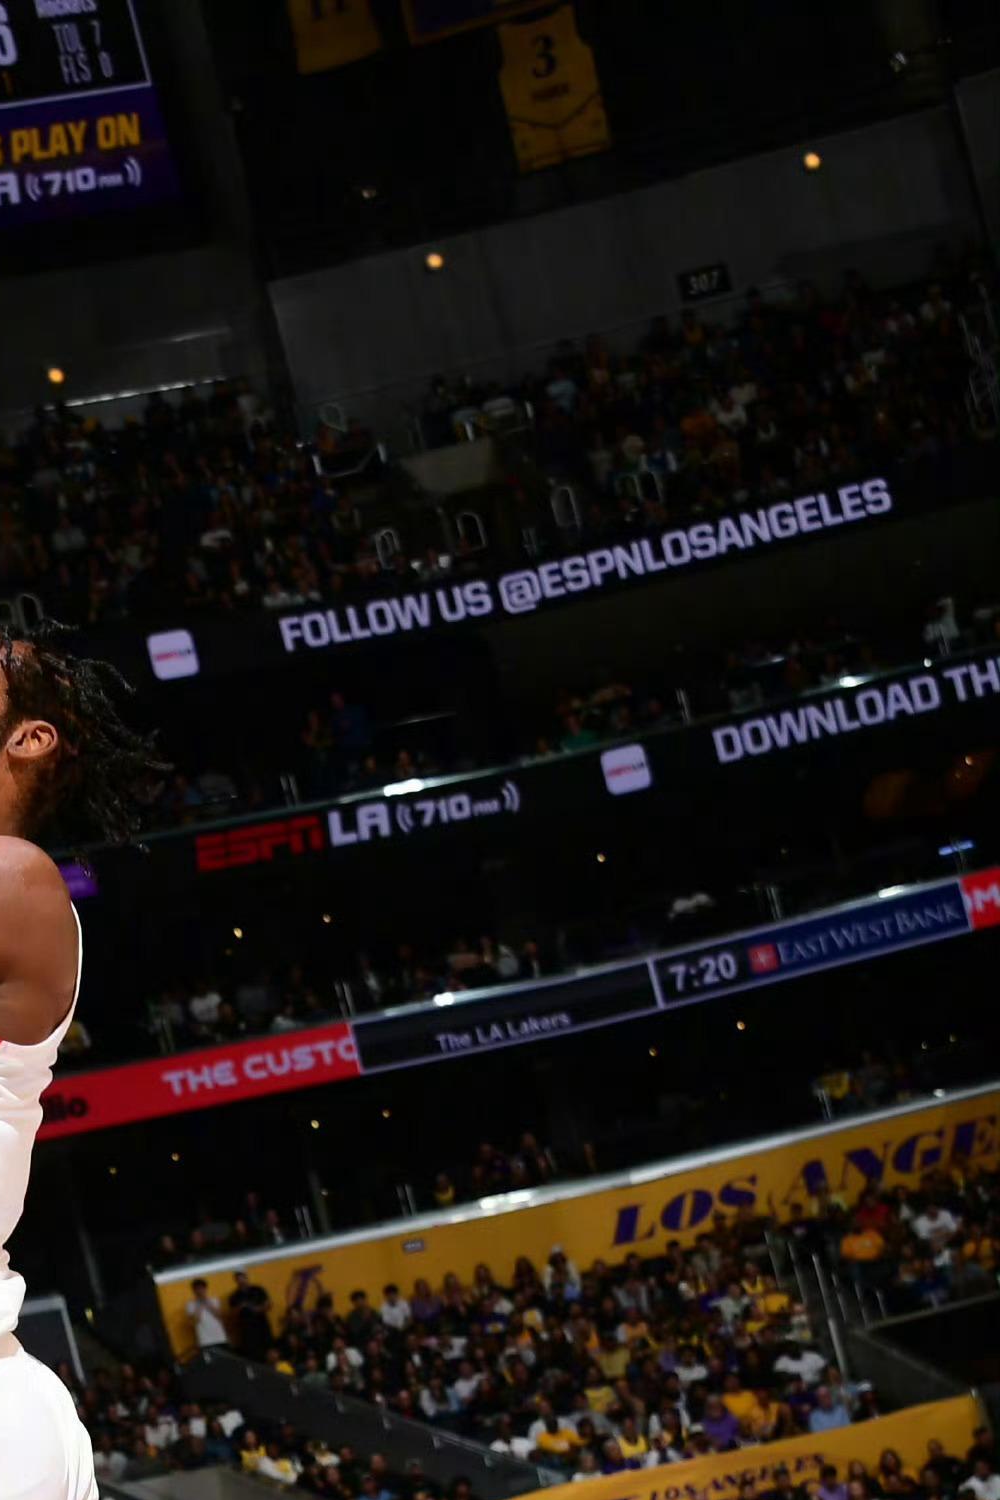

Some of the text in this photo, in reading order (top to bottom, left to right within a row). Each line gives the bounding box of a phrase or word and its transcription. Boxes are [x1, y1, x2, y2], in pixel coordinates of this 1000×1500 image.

[10, 120, 88, 163] PLAY
[96, 113, 141, 147] ON
[279, 478, 893, 652] FOLLOW US @ESPNLOSANGELES
[712, 675, 941, 764] DOWNLOAD
[195, 816, 325, 872] ESPN
[327, 803, 392, 847] LA
[669, 952, 737, 992] 7:20
[437, 1011, 573, 1053] The LA Lakers
[163, 1062, 236, 1097] THE
[613, 1174, 758, 1246] LOS
